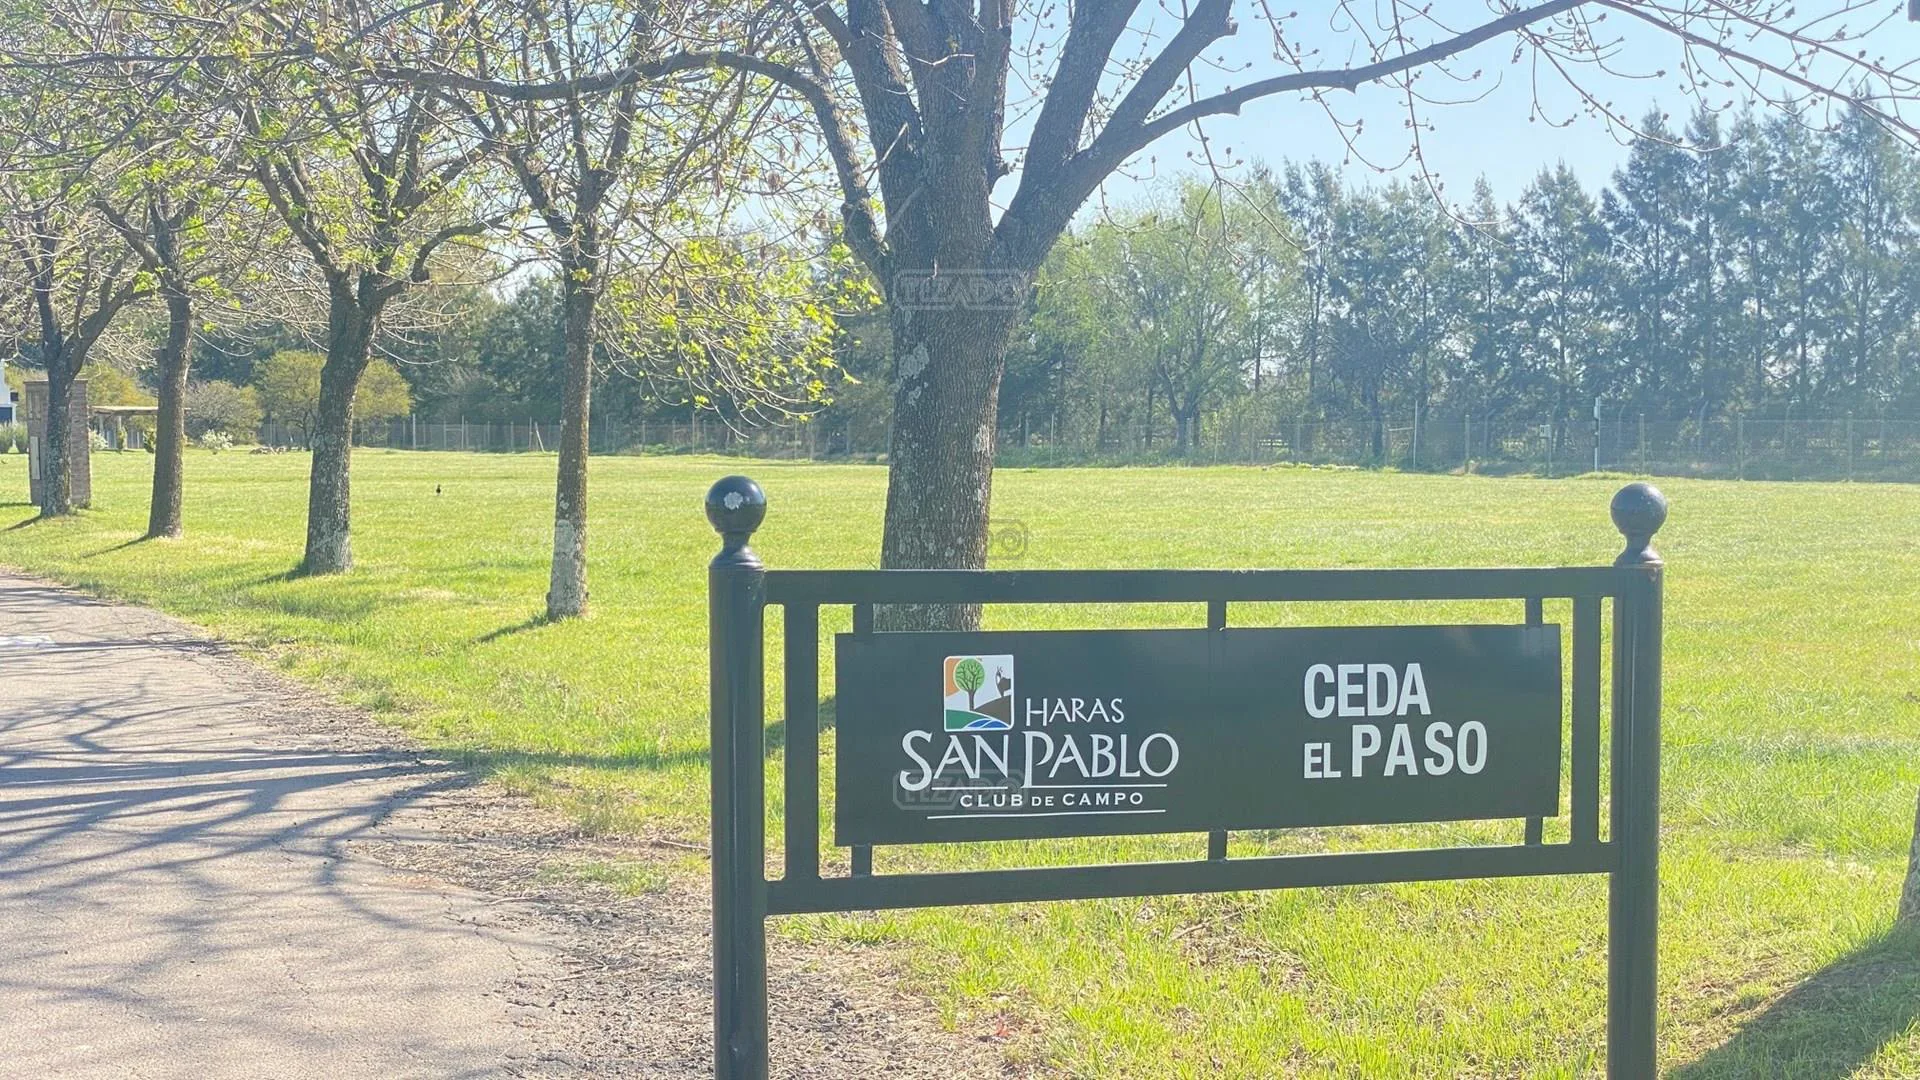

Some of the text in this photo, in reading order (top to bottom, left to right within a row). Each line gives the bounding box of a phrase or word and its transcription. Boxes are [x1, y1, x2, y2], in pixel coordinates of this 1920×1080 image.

[1025, 697, 1125, 727] HARAS
[1304, 662, 1432, 719] CEDA
[899, 729, 1180, 792] SAN PABLO
[1303, 720, 1488, 779] EL PASO
[959, 791, 1143, 808] CLUB DE CAMPO
